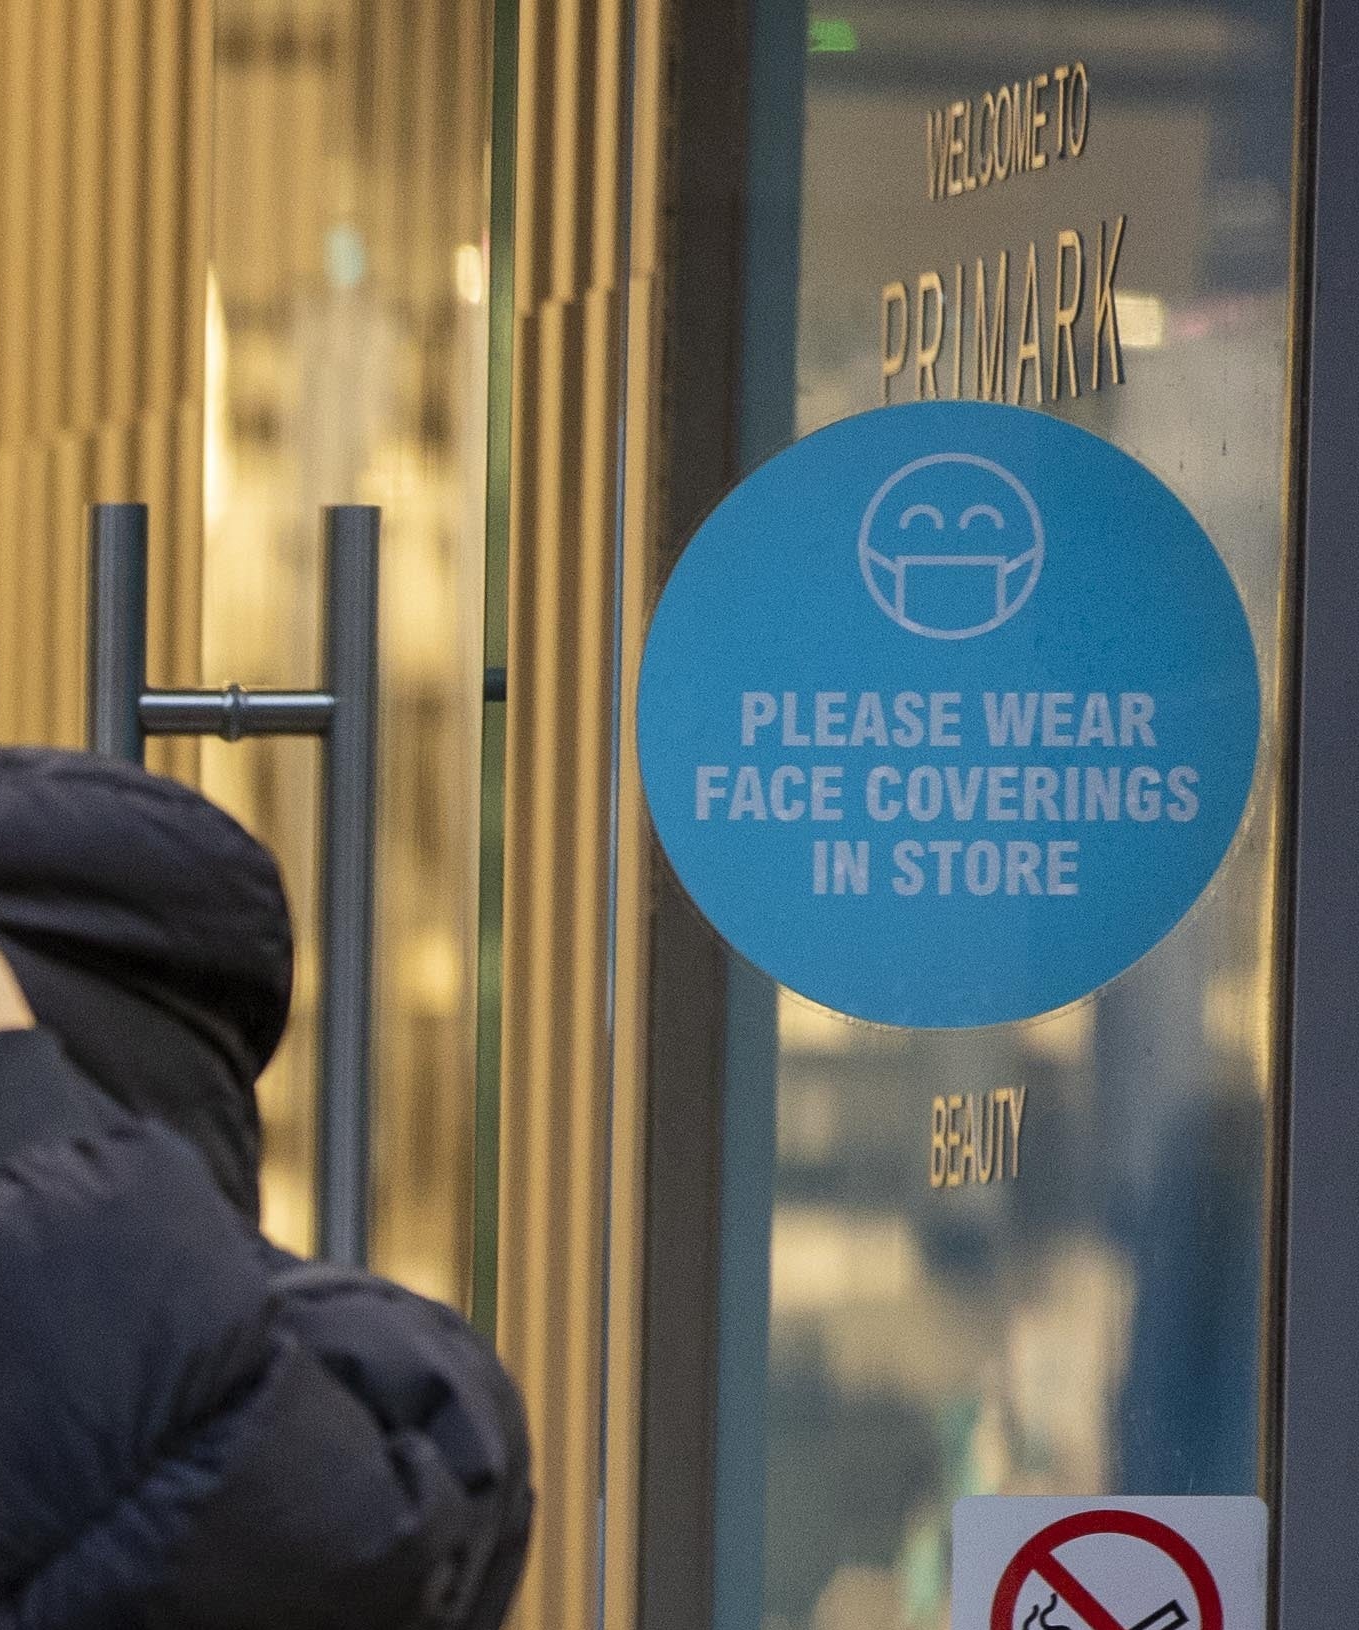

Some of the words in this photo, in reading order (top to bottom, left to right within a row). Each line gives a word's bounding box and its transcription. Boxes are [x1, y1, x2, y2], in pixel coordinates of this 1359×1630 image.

[925, 73, 1049, 201] WELCOME
[1054, 60, 1088, 158] TO
[883, 214, 1127, 406] PRIMARK
[740, 691, 963, 748] PLEASE
[982, 691, 1159, 748] WEAR
[694, 764, 845, 822] FACE
[865, 763, 1201, 823] COVERINGS
[811, 839, 871, 897] IN
[891, 838, 1080, 898] STORE
[929, 1084, 1027, 1190] BEAUTY
